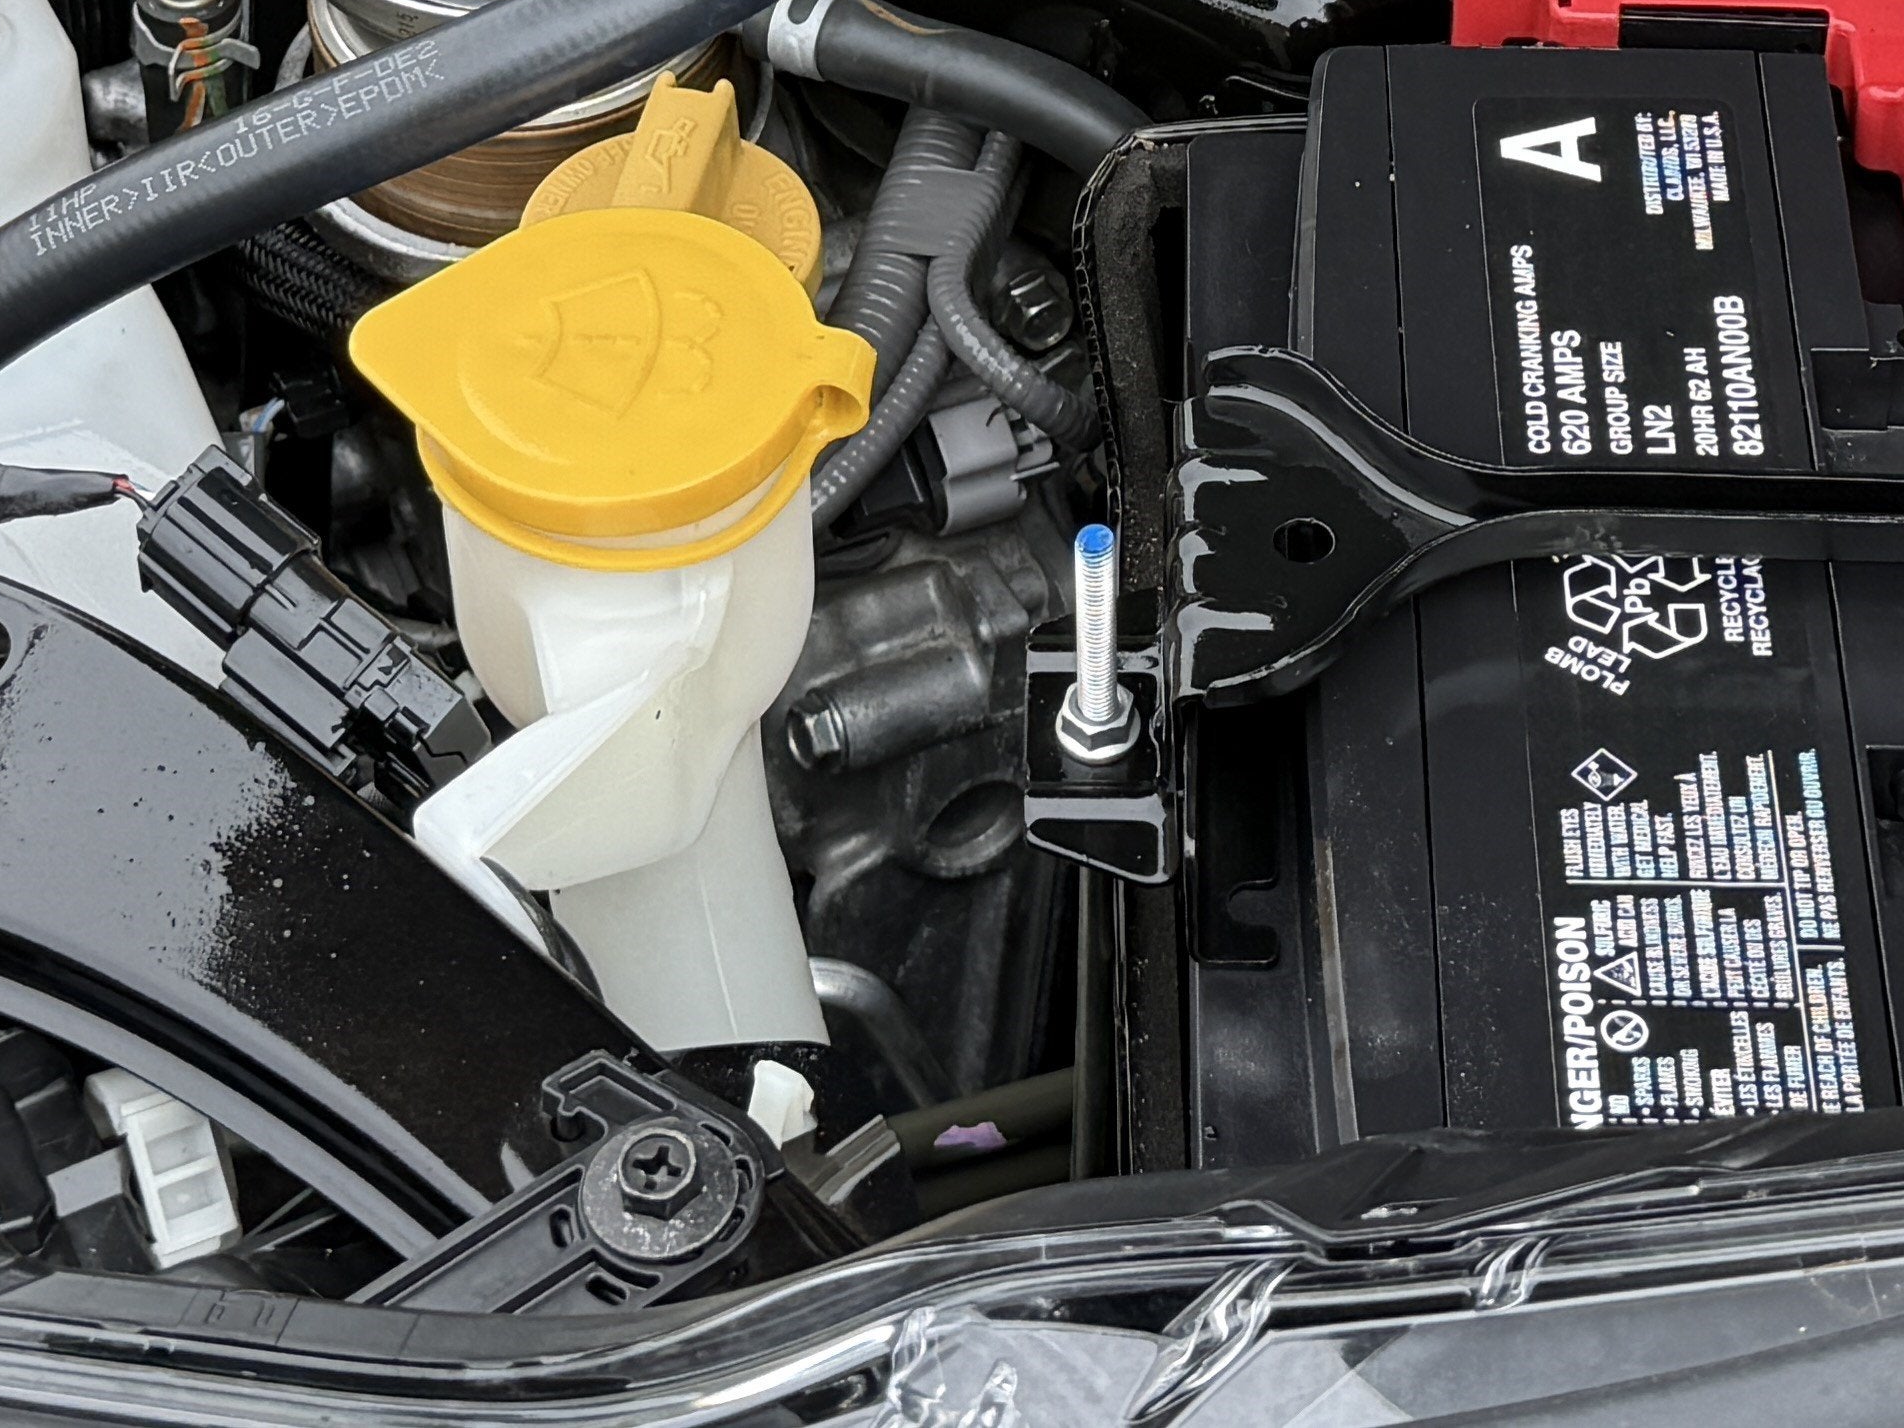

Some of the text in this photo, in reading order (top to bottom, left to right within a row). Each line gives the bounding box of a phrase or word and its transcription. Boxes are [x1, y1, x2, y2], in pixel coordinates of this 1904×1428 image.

[1500, 117, 1602, 182] A
[1637, 134, 1664, 214] DISTRIBUTED
[1706, 149, 1725, 163] IN
[1709, 166, 1730, 202] MADE
[1510, 245, 1551, 454] COLD CRANKING AMPS
[1713, 295, 1764, 456] 82110AN00B
[1551, 329, 1592, 455] 620 AMPS
[1600, 341, 1633, 455] GROUP SIZE
[1683, 347, 1719, 456] 20HR 62 AH
[1642, 404, 1676, 454] LN2
[1623, 578, 1653, 614] Pb
[1544, 646, 1631, 696] PLOMB
[1568, 635, 1632, 673] LEAD
[1679, 783, 1700, 812] YEUX
[1806, 800, 1825, 818] OU
[1560, 808, 1584, 877] FLUSH EYES
[1583, 801, 1607, 877] IMMEDIATELY
[1654, 812, 1679, 878] HELP FAST.
[1682, 815, 1703, 836] LES
[1635, 855, 1656, 878] GET
[1785, 811, 1819, 939] DO NOT TIP OR OPEN.
[1809, 820, 1835, 893] RENVERSER
[1742, 919, 1763, 941] DES
[1818, 895, 1838, 920] PAS
[1822, 921, 1841, 939] NE
[1717, 908, 1746, 998] PEUT CAUSER LA
[1805, 964, 1831, 1033] CHILDREN.
[1827, 957, 1852, 1020] ENFANTS.
[1554, 916, 1604, 1130] NGER/POISON
[1814, 1035, 1833, 1052] OF
[1632, 1056, 1654, 1106] SPARKS
[1657, 1056, 1679, 1107] FLAMES
[1680, 1049, 1704, 1107] SMOKING
[1755, 1022, 1783, 1108] LES FLAMMES
[1783, 1045, 1808, 1108] DE FUMER
[1816, 1055, 1840, 1100] REACH
[1835, 1041, 1862, 1093] PORTÉE
[1738, 1084, 1759, 1106] LES
[1844, 1095, 1865, 1113] LA
